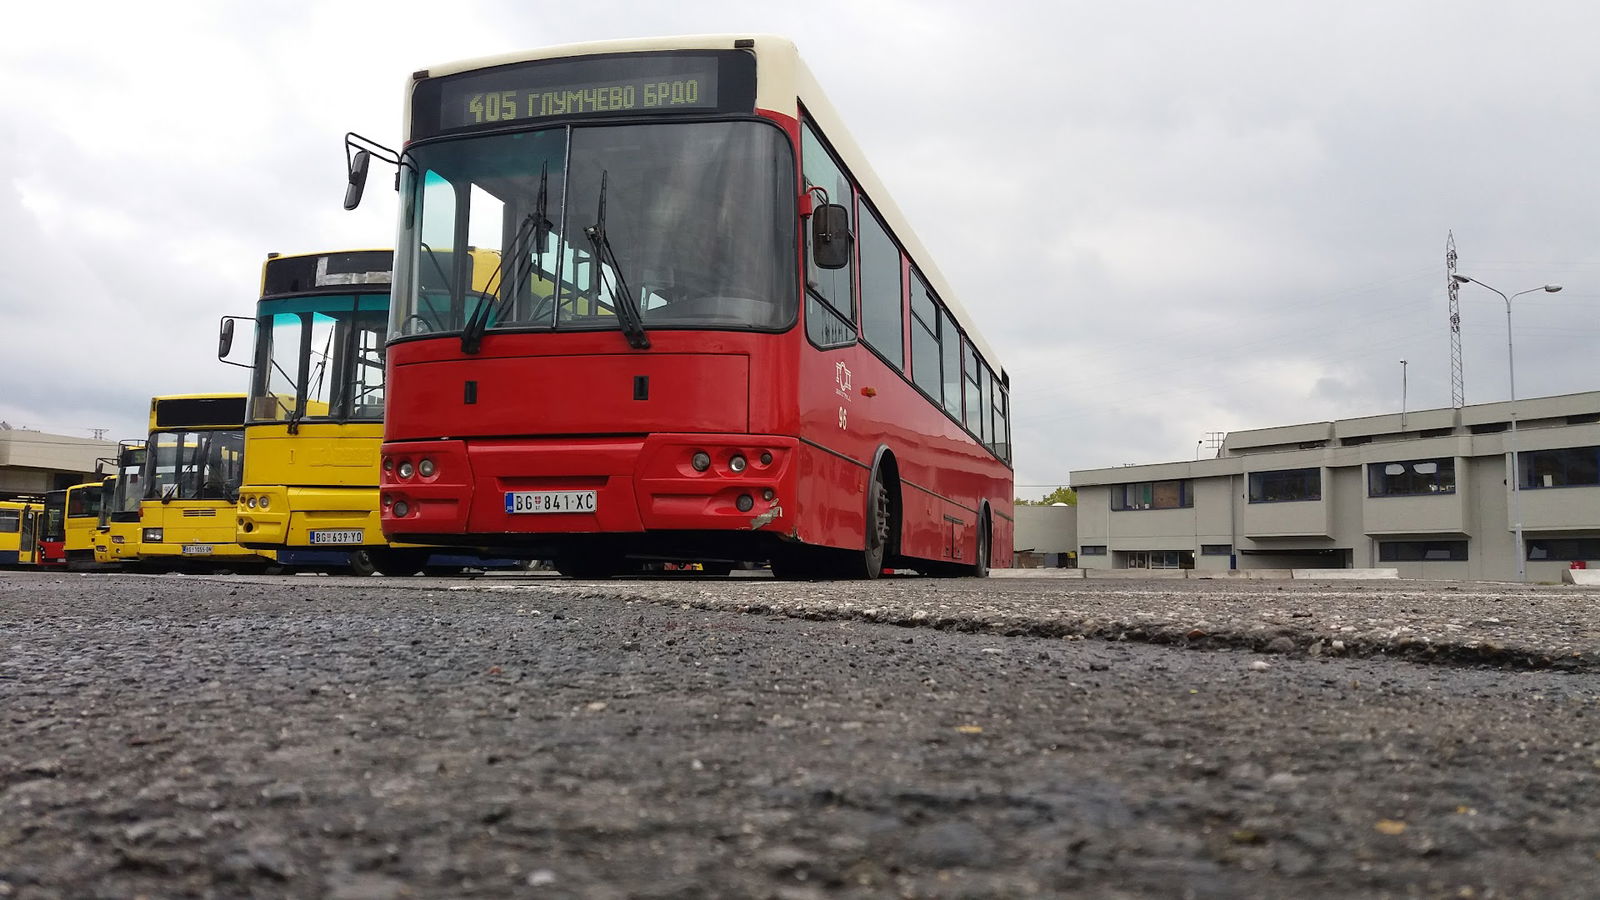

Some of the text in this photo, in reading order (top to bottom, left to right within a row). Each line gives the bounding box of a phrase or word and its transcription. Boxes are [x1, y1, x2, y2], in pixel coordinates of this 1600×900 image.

[469, 79, 698, 123] 405 ГЛУМЧЕВО БРДО
[838, 406, 848, 431] 96
[516, 495, 533, 511] BG
[316, 532, 327, 543] BG
